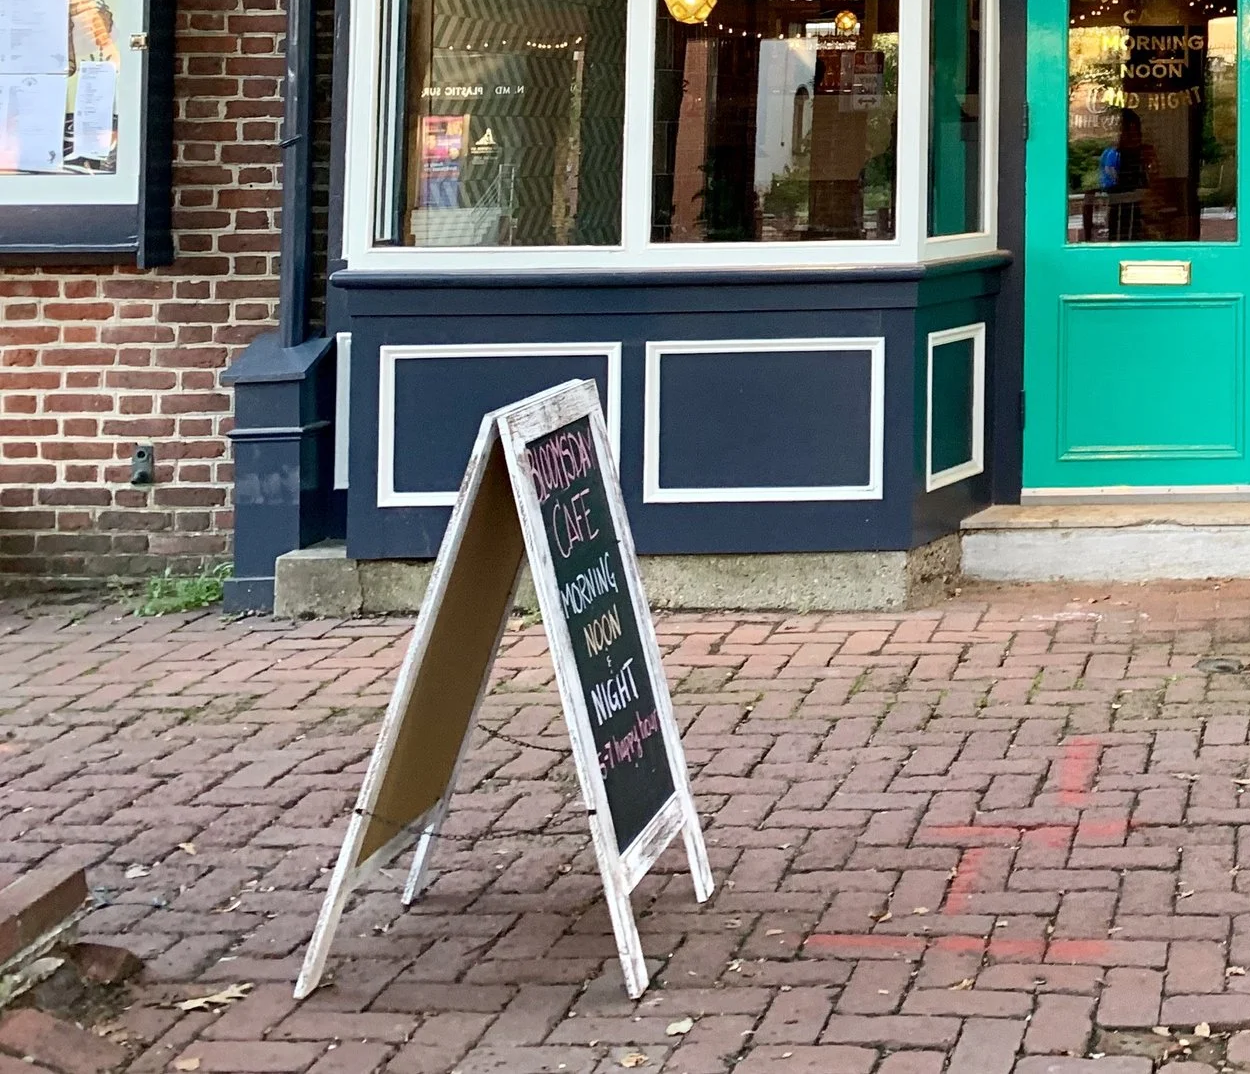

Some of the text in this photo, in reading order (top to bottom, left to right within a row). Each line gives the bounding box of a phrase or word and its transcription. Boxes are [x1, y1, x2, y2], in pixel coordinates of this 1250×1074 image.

[1102, 35, 1205, 51] MORNING
[1120, 64, 1183, 78] NOON
[1101, 86, 1202, 111] AND NIGHT
[526, 426, 596, 505] BLOOMSDAY
[553, 488, 599, 558] CAFE
[560, 551, 619, 619] MORNING
[583, 604, 622, 657] NOON
[591, 657, 639, 726] NIGHT
